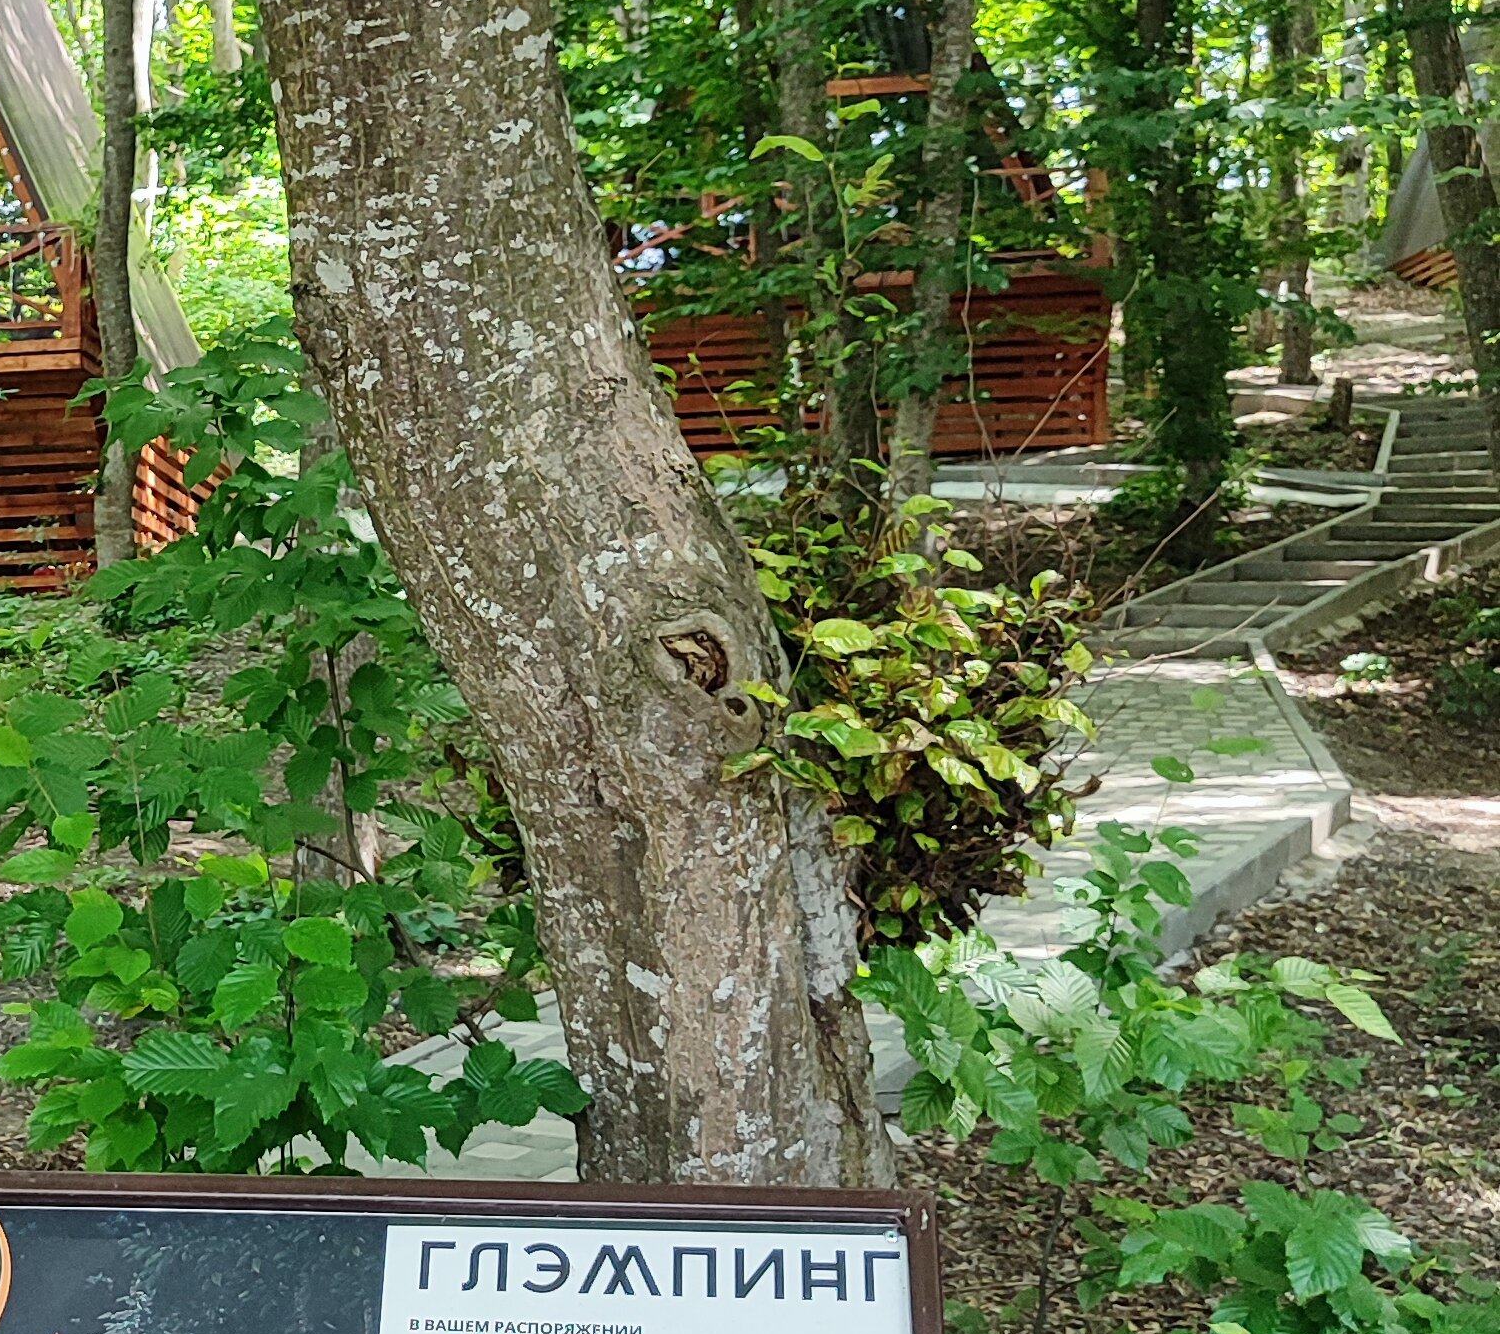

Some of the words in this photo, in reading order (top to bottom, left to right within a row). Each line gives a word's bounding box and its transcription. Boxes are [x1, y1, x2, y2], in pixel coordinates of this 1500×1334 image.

[418, 1240, 901, 1302] ГЛЭМПИНГ
[409, 1318, 420, 1331] В
[424, 1319, 490, 1333] ВАШЕМ
